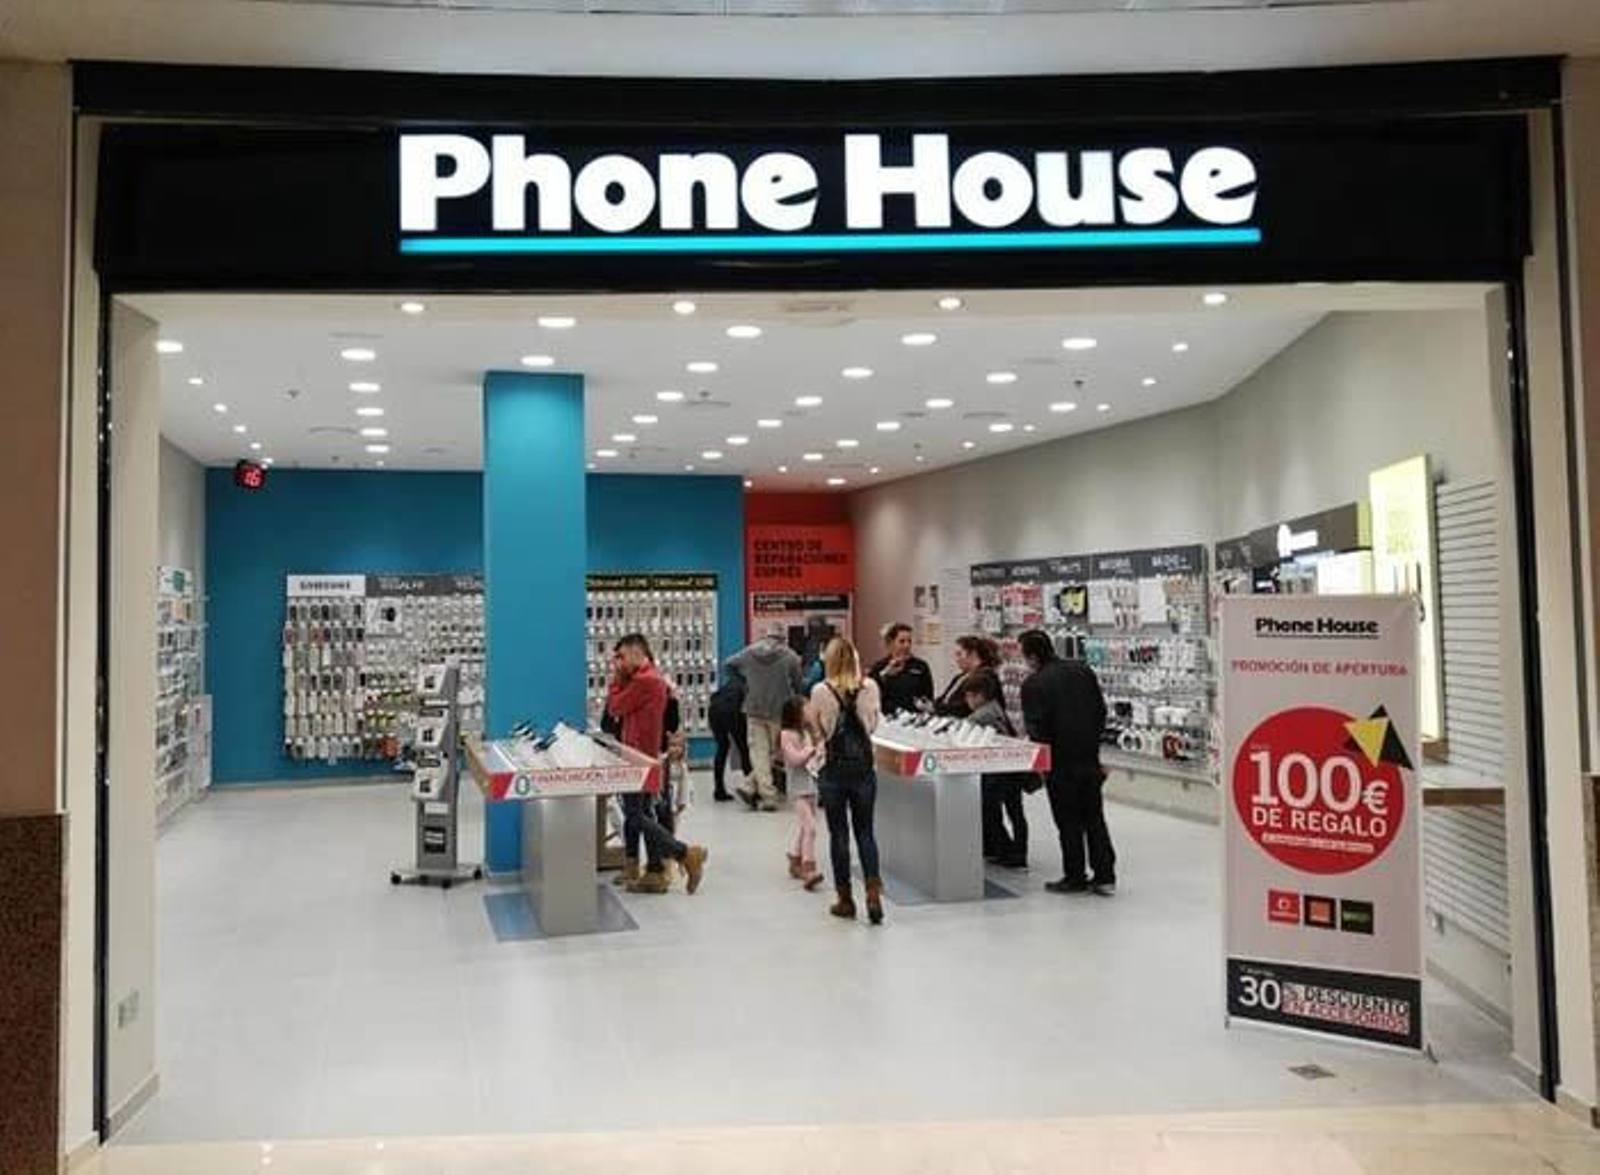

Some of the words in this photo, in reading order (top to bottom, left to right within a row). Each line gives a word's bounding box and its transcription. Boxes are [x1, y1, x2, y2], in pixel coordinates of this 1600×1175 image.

[400, 134, 818, 232] Phone
[844, 133, 1257, 228] House
[1256, 617, 1313, 633] Phone
[1317, 617, 1379, 633] House
[1313, 661, 1330, 674] DE
[1336, 662, 1408, 677] APERTURA
[1250, 750, 1389, 815] 100€
[1252, 807, 1283, 828] DE
[1290, 810, 1387, 837] REGALO
[1239, 976, 1281, 1010] 30
